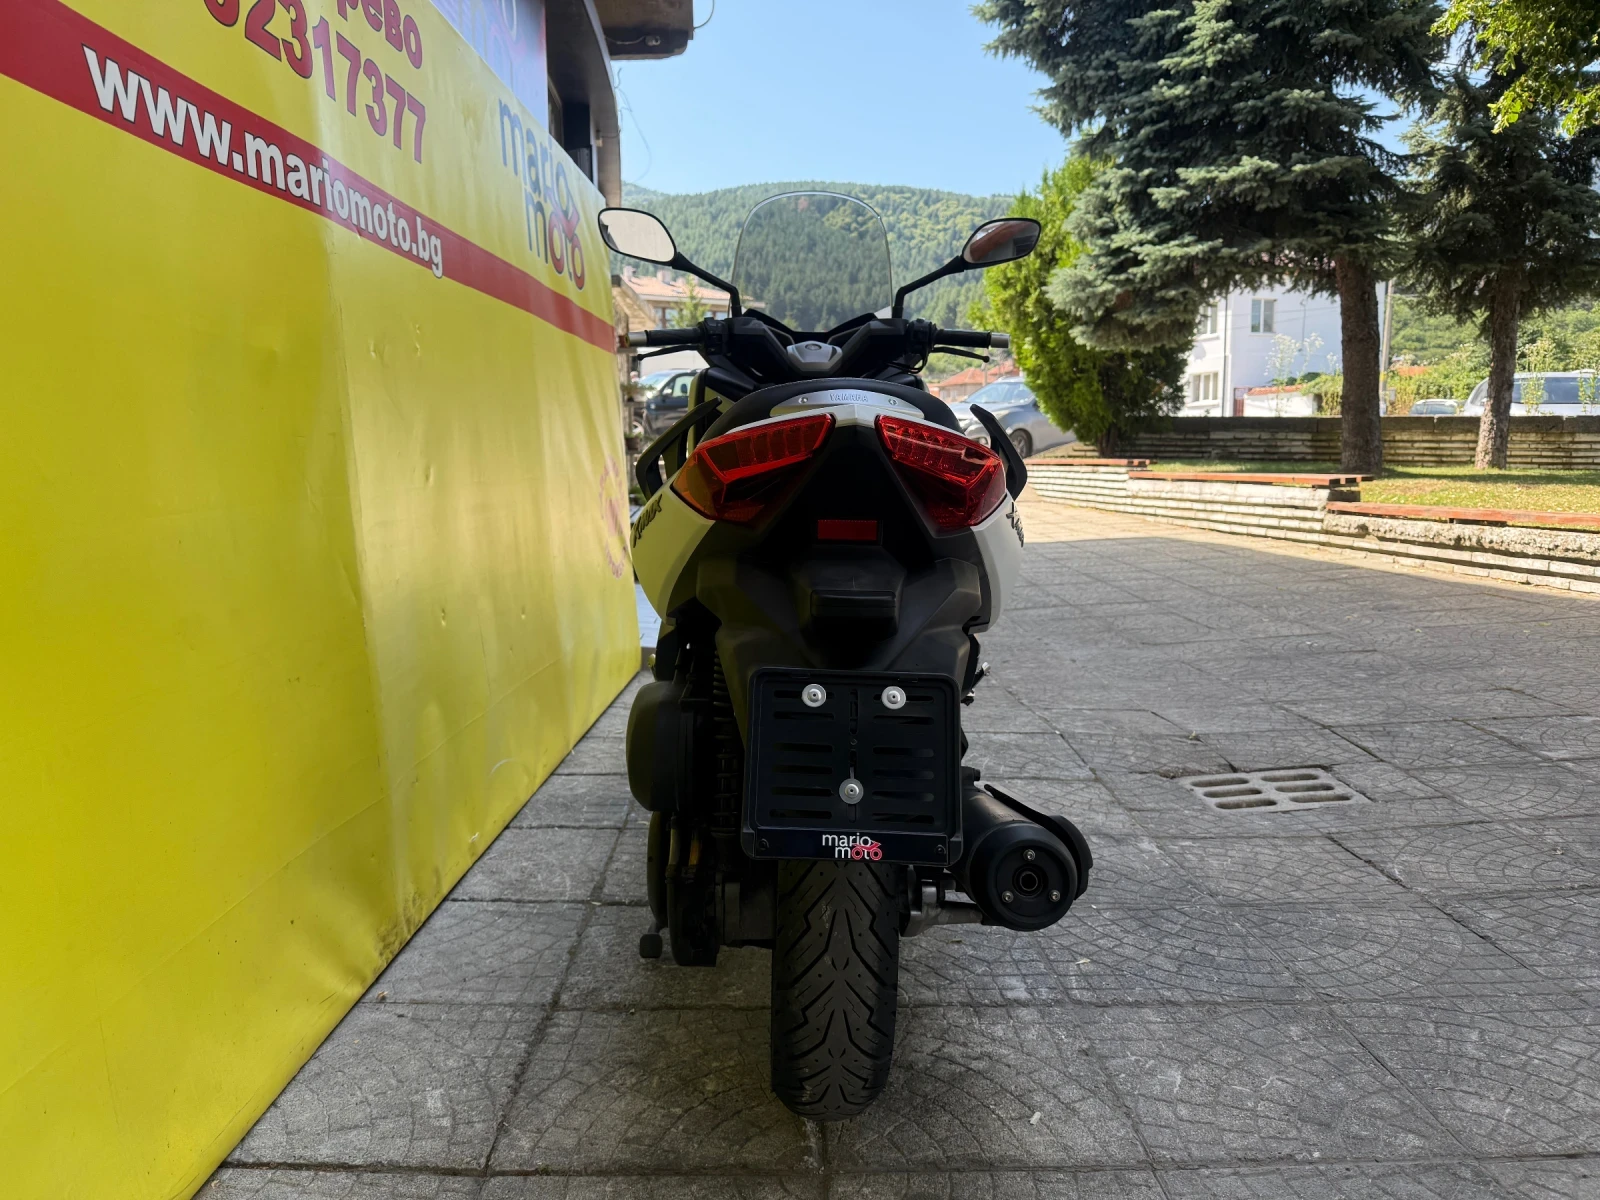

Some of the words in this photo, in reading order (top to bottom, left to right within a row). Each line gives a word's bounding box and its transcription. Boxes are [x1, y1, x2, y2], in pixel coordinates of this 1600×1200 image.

[204, 0, 426, 164] 2317377
[82, 43, 443, 279] www.mariomoto.bg
[499, 98, 572, 222] mario
[524, 187, 586, 290] moto
[829, 393, 869, 402] YAMAHA
[822, 832, 871, 847] mario
[835, 846, 882, 861] moto
